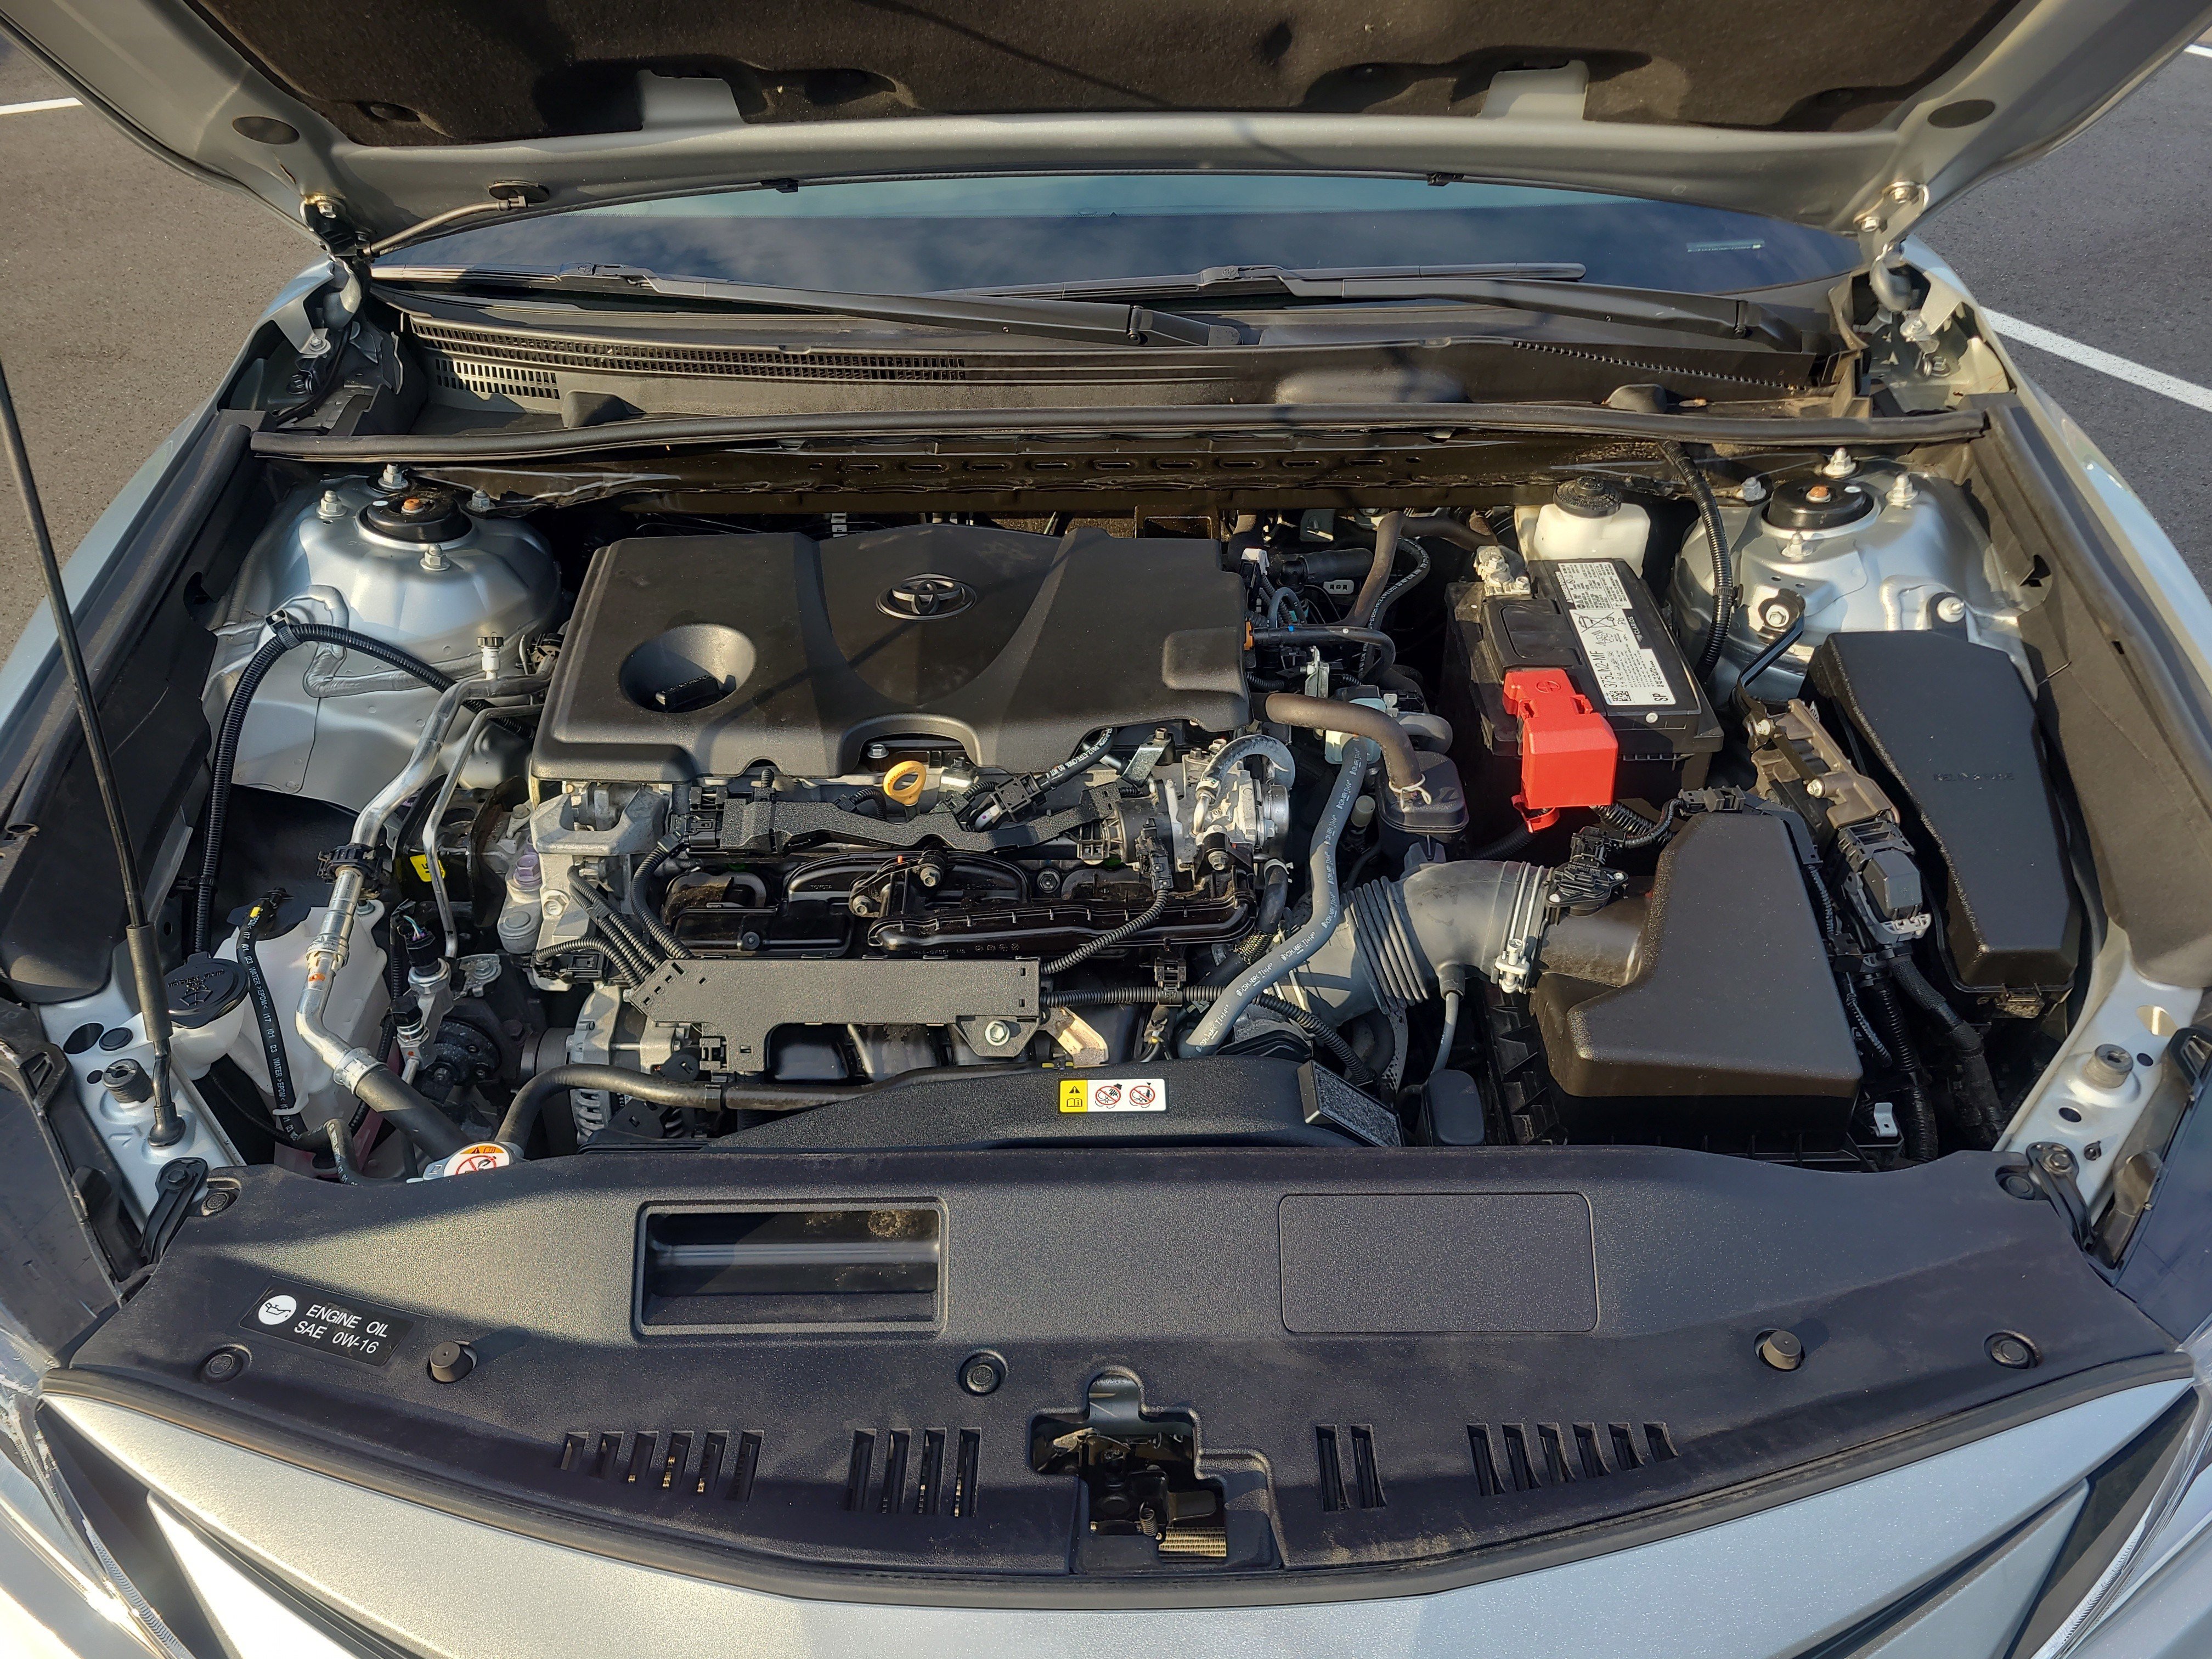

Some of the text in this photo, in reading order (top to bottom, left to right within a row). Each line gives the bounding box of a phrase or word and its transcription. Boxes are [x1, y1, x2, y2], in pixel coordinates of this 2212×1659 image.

[1590, 651, 1618, 688] 375LN2-MF
[1654, 693, 1669, 702] SP
[249, 967, 261, 986] WATER
[273, 1057, 283, 1078] WATER
[294, 1321, 380, 1354] SAE 0W-16
[306, 1304, 388, 1338] ENGINE OIL
